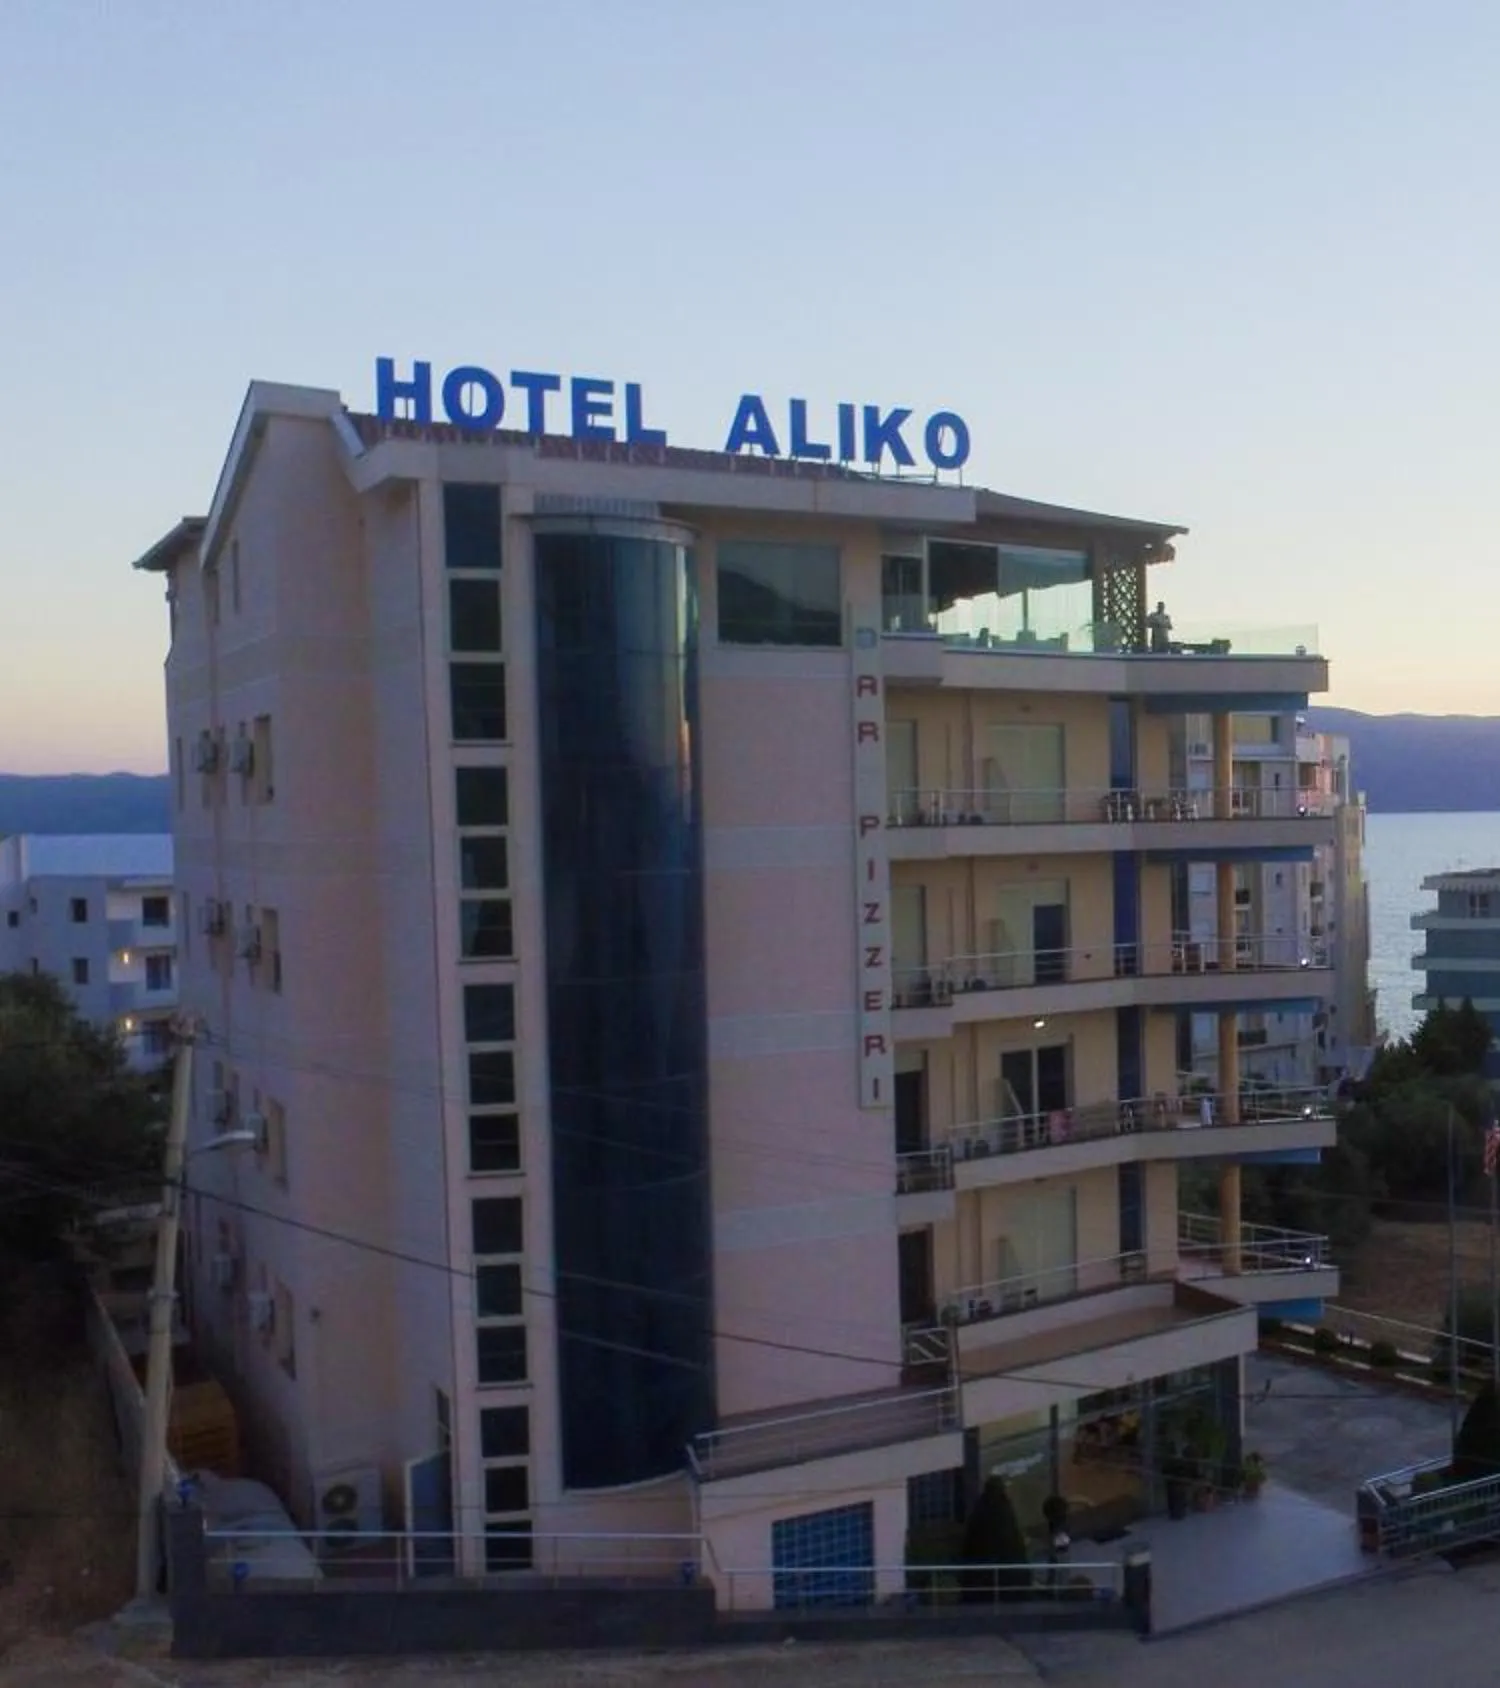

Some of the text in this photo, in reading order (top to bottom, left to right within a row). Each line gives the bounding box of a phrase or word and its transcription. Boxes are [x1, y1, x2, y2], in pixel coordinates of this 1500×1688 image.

[376, 356, 972, 470] HOTEL ALIKO
[859, 815, 886, 1100] PIZZERI
